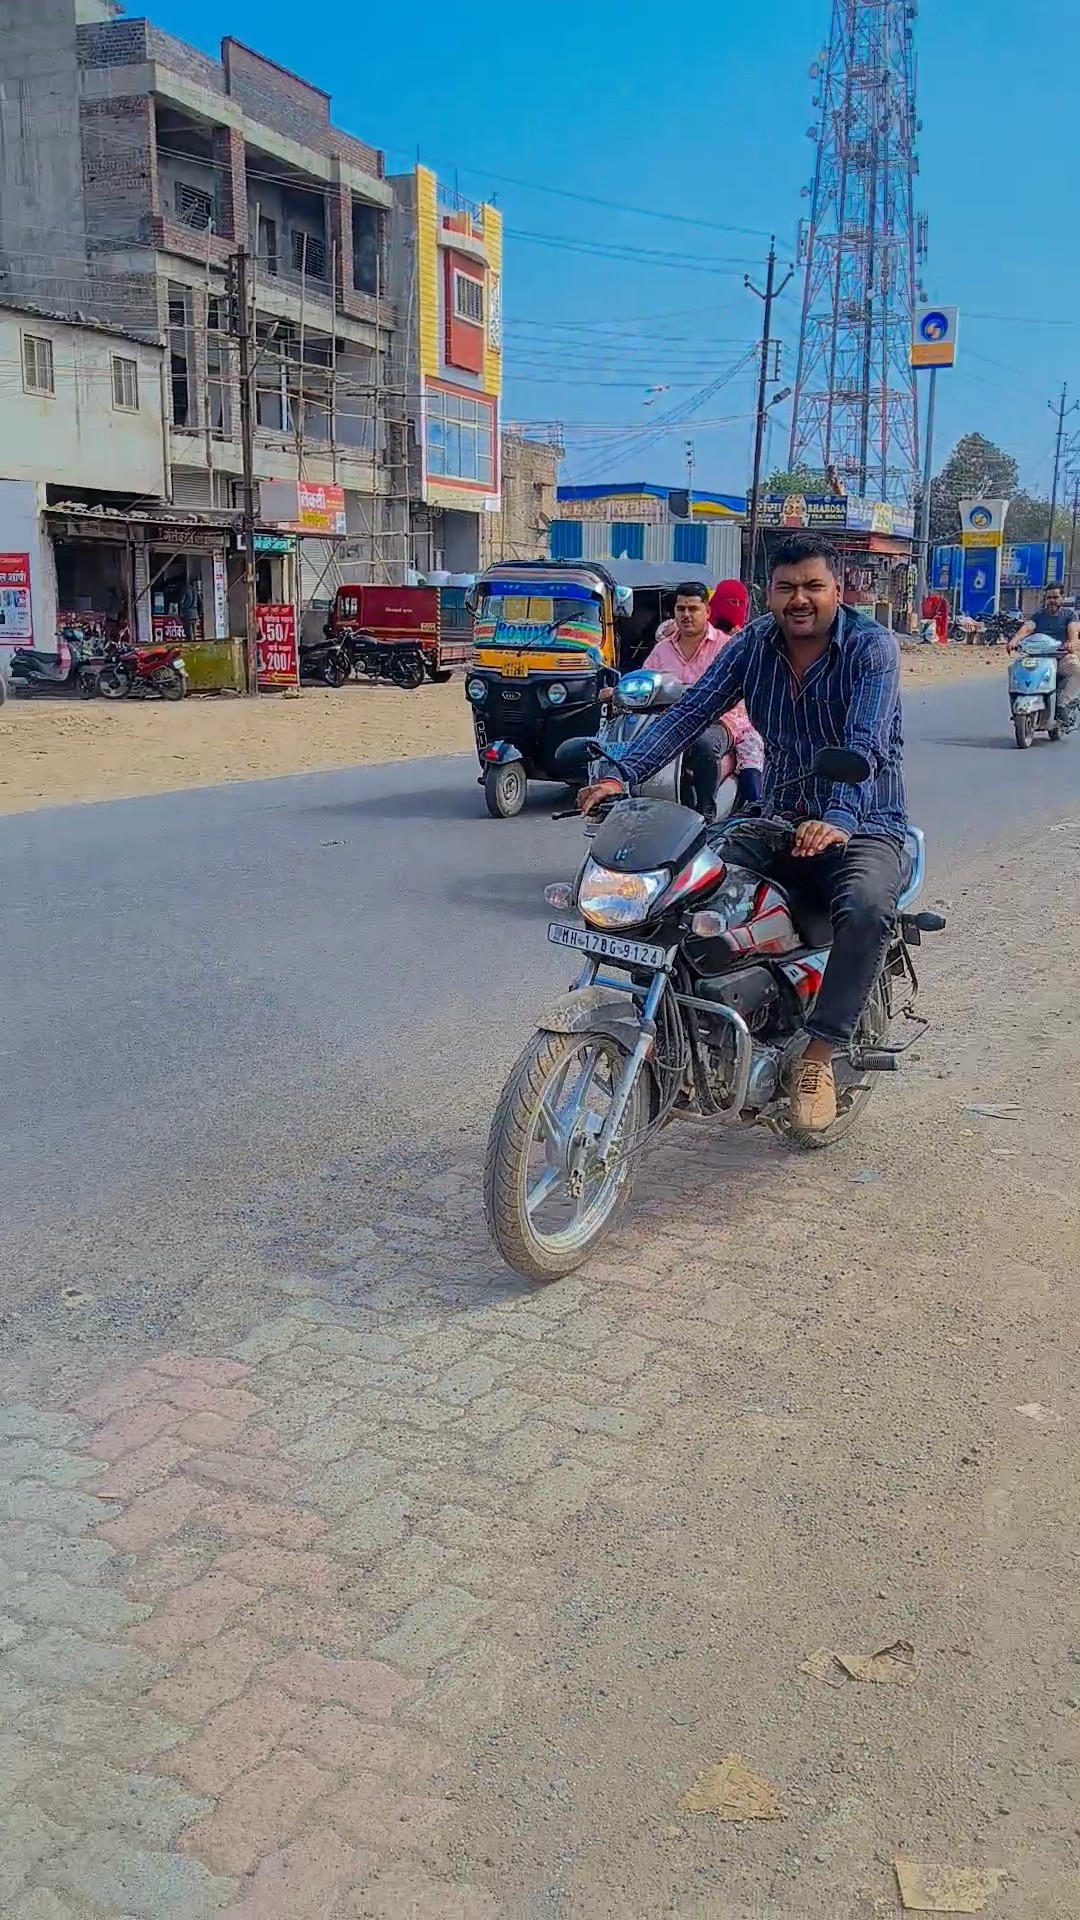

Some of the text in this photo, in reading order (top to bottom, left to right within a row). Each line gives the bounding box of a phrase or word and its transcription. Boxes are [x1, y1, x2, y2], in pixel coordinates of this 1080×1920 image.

[807, 503, 846, 513] BHAROSA
[266, 623, 294, 642] 50/-
[267, 652, 296, 671] 200/-
[562, 929, 577, 945] MH
[624, 945, 657, 964] 9124
